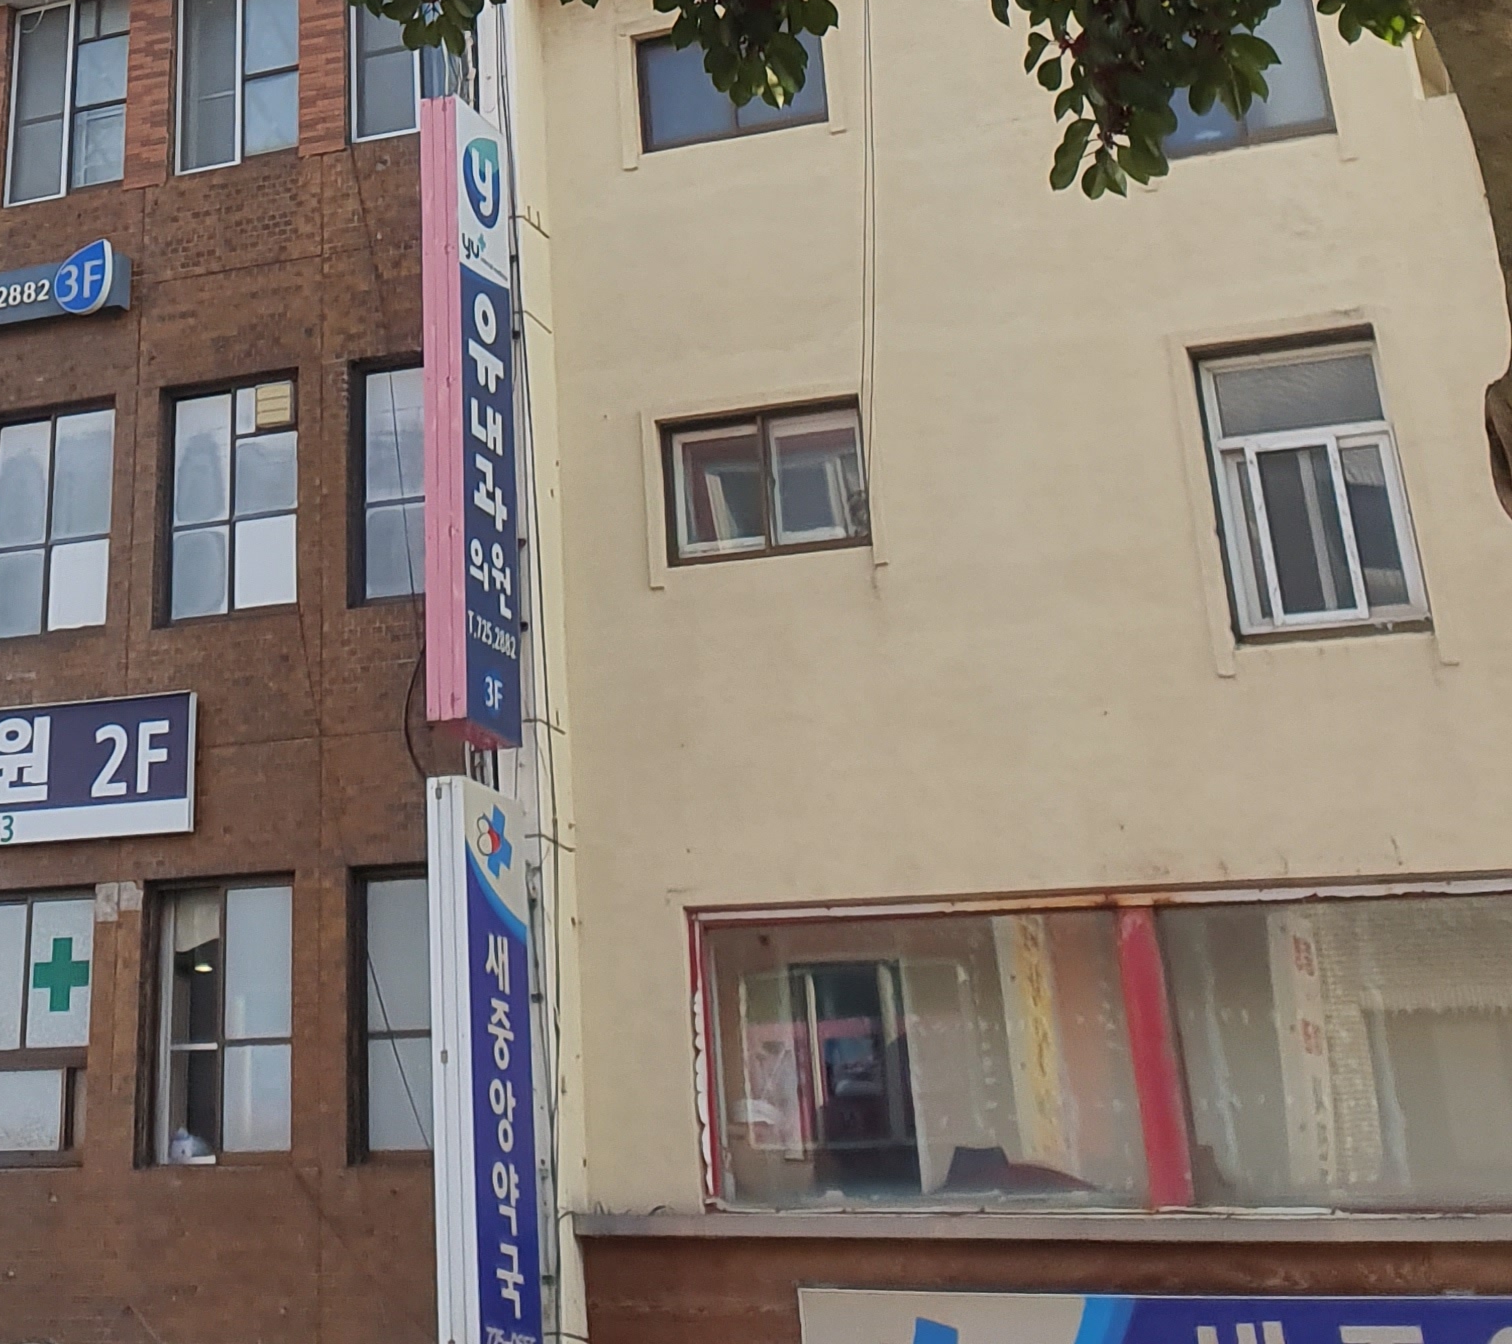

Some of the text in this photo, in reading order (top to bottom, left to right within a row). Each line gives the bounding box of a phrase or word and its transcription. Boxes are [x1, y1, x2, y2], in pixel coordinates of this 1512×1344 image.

[59, 263, 104, 300] 3F
[484, 675, 504, 711] 3F
[89, 719, 172, 801] 2F
[485, 932, 525, 1320] 새중앙약국
